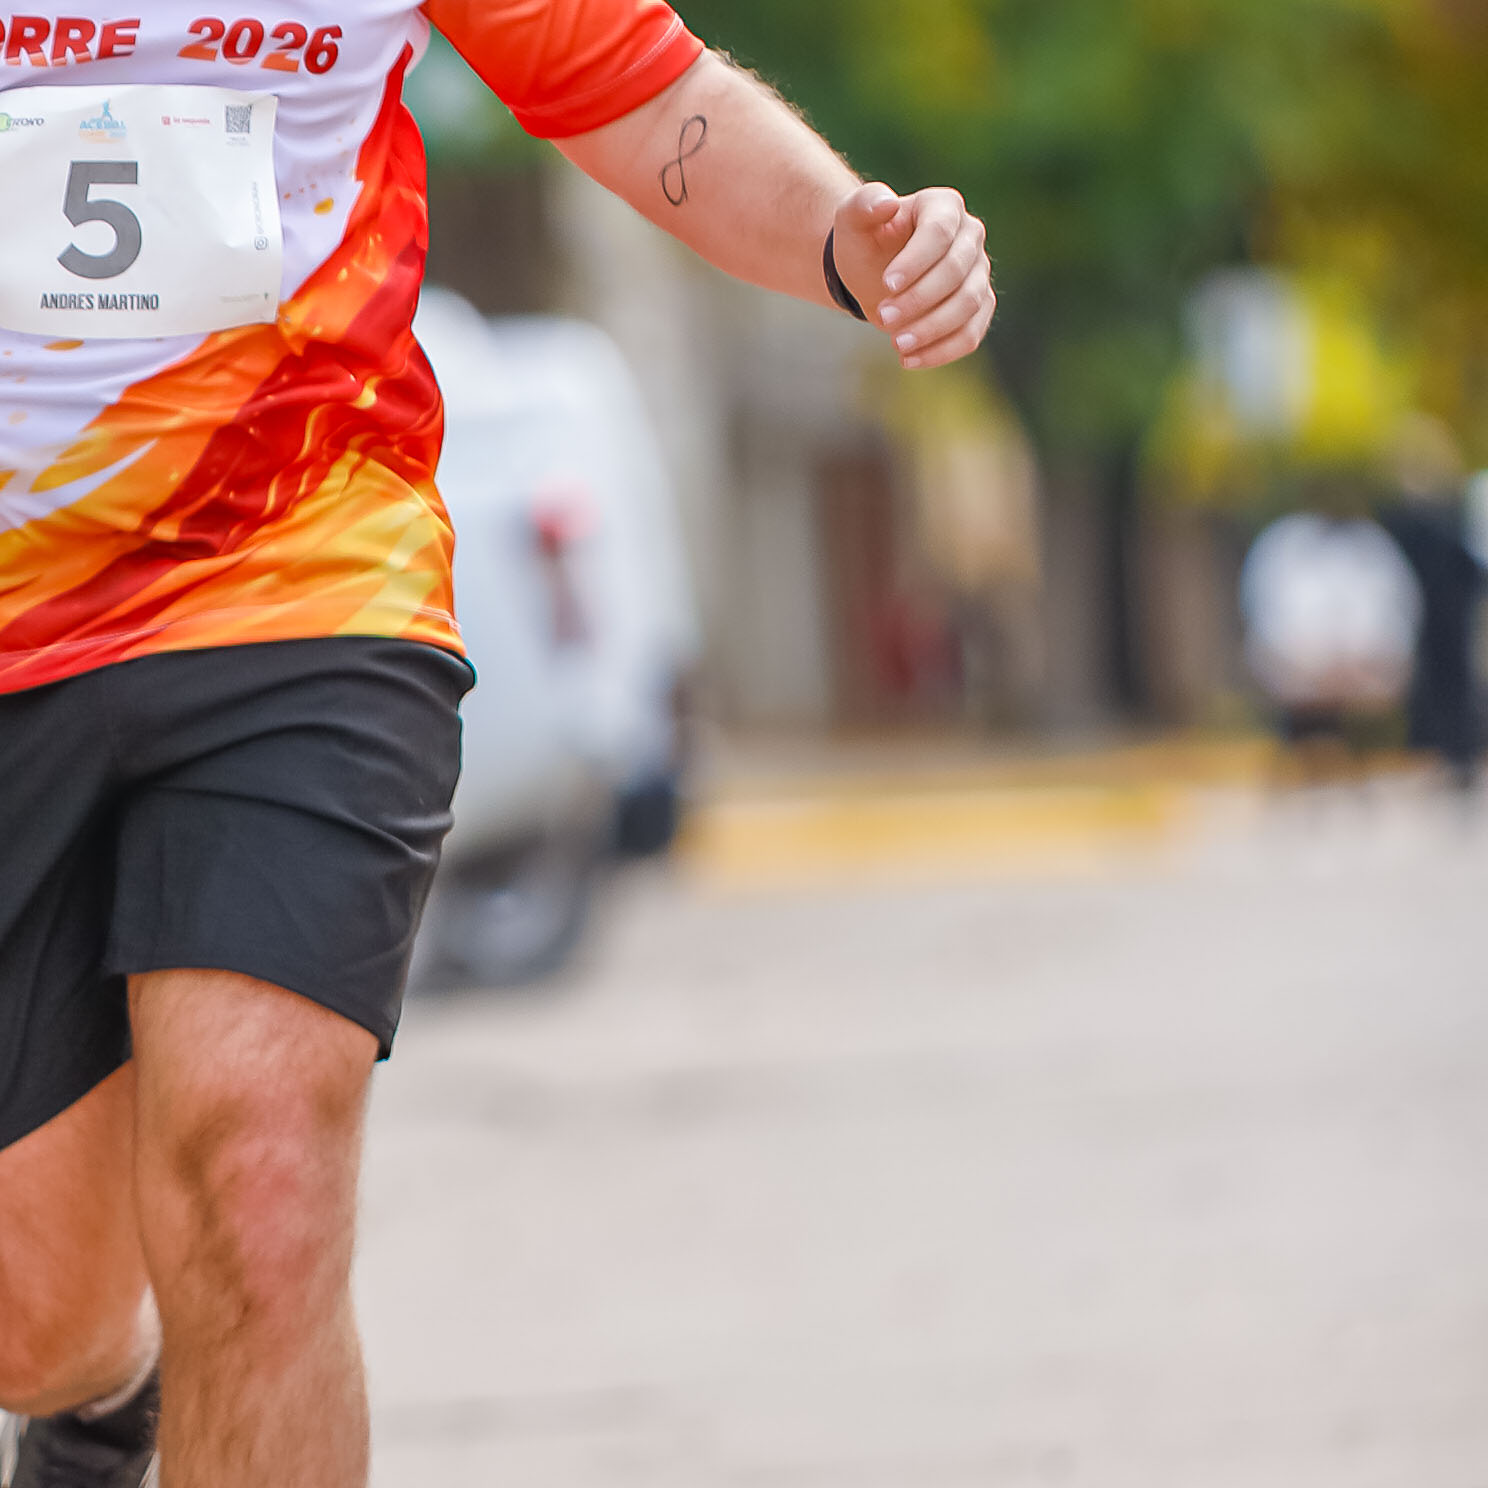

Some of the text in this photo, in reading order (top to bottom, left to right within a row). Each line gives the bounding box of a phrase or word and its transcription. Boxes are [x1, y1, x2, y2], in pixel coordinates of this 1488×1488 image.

[176, 17, 343, 75] 2026
[56, 160, 143, 280] 5
[40, 293, 160, 311] ANDRES MARTINO
